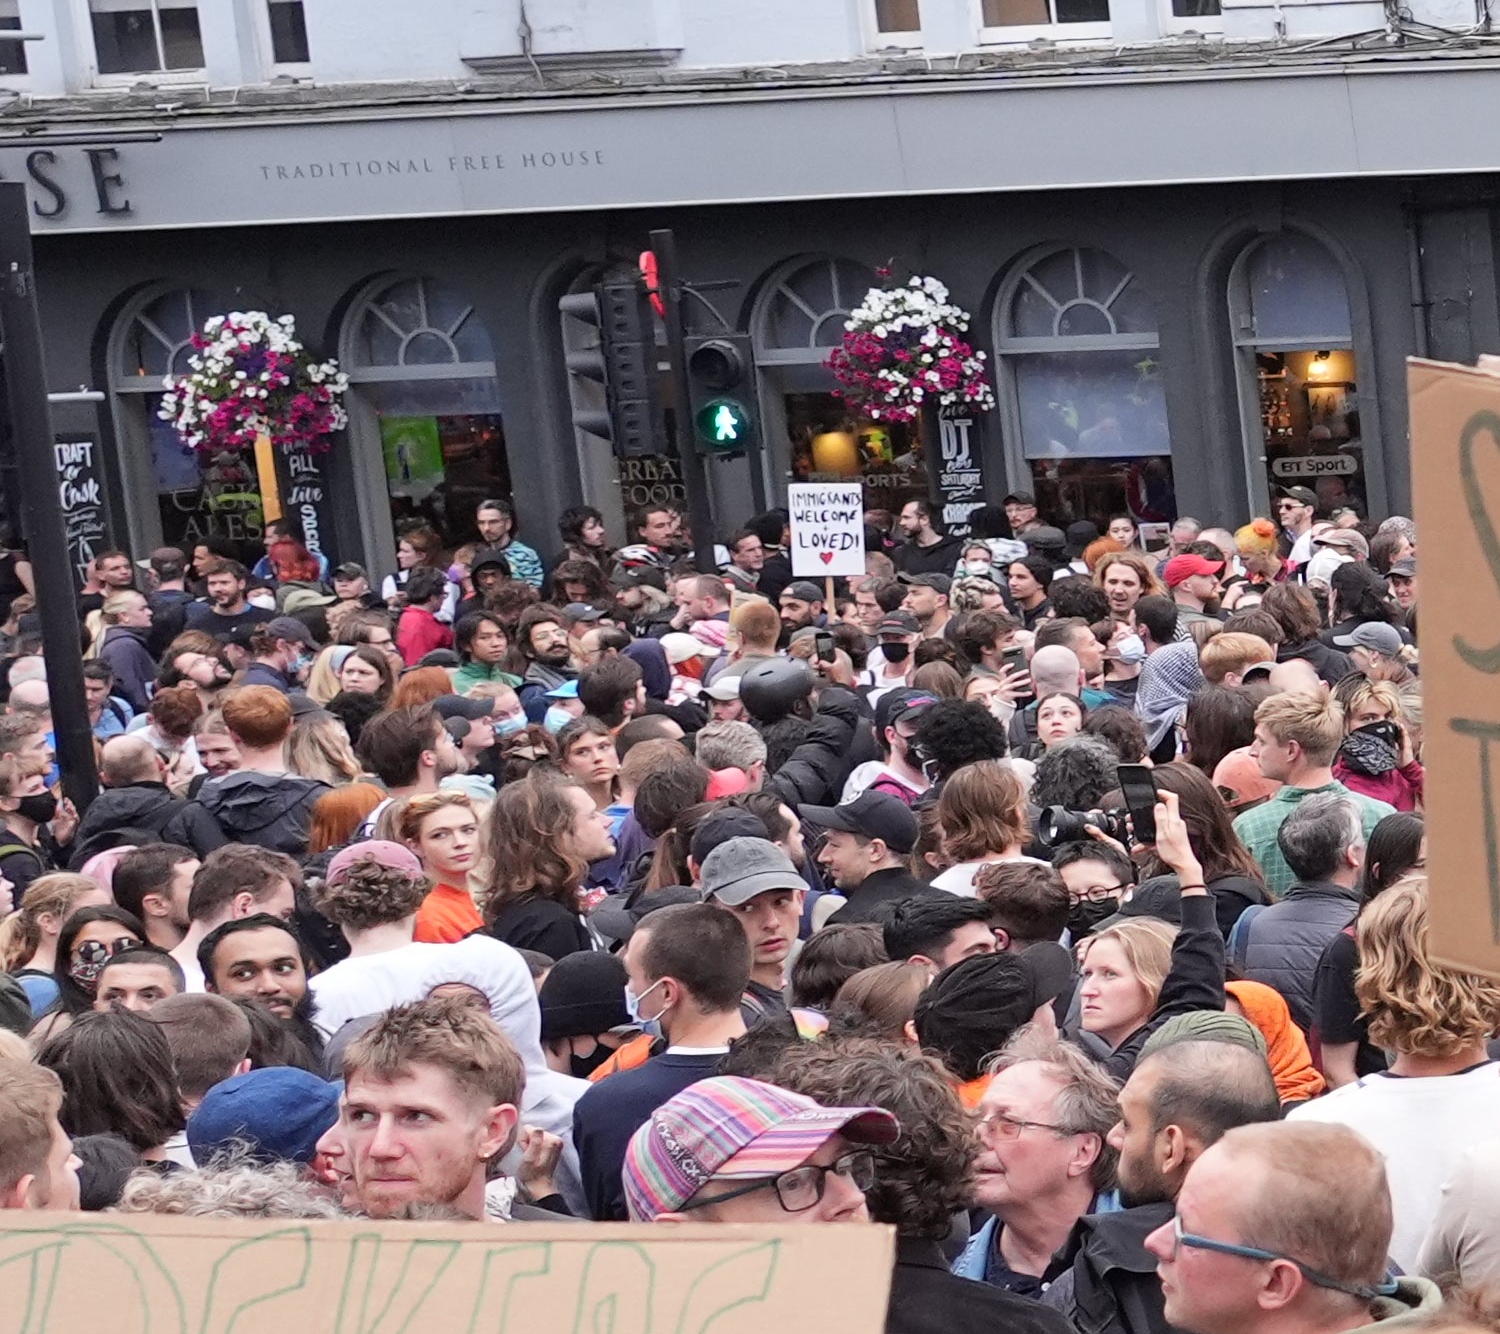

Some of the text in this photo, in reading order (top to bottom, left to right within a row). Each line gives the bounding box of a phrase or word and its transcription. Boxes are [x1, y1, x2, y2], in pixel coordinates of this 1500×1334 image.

[261, 148, 607, 182] TRADITIONAL FREE HOUSE
[938, 419, 972, 461] DJ
[54, 441, 93, 471] CRAFT
[288, 454, 320, 478] ALL
[1281, 458, 1347, 474] BT Sport
[59, 477, 102, 511] Cask
[171, 481, 262, 512] CASK
[287, 485, 324, 506] Live
[792, 491, 863, 510] IMMIGRANTS
[184, 514, 263, 541] ALES
[795, 509, 858, 524] WELCOME
[800, 531, 860, 551] LOVED!
